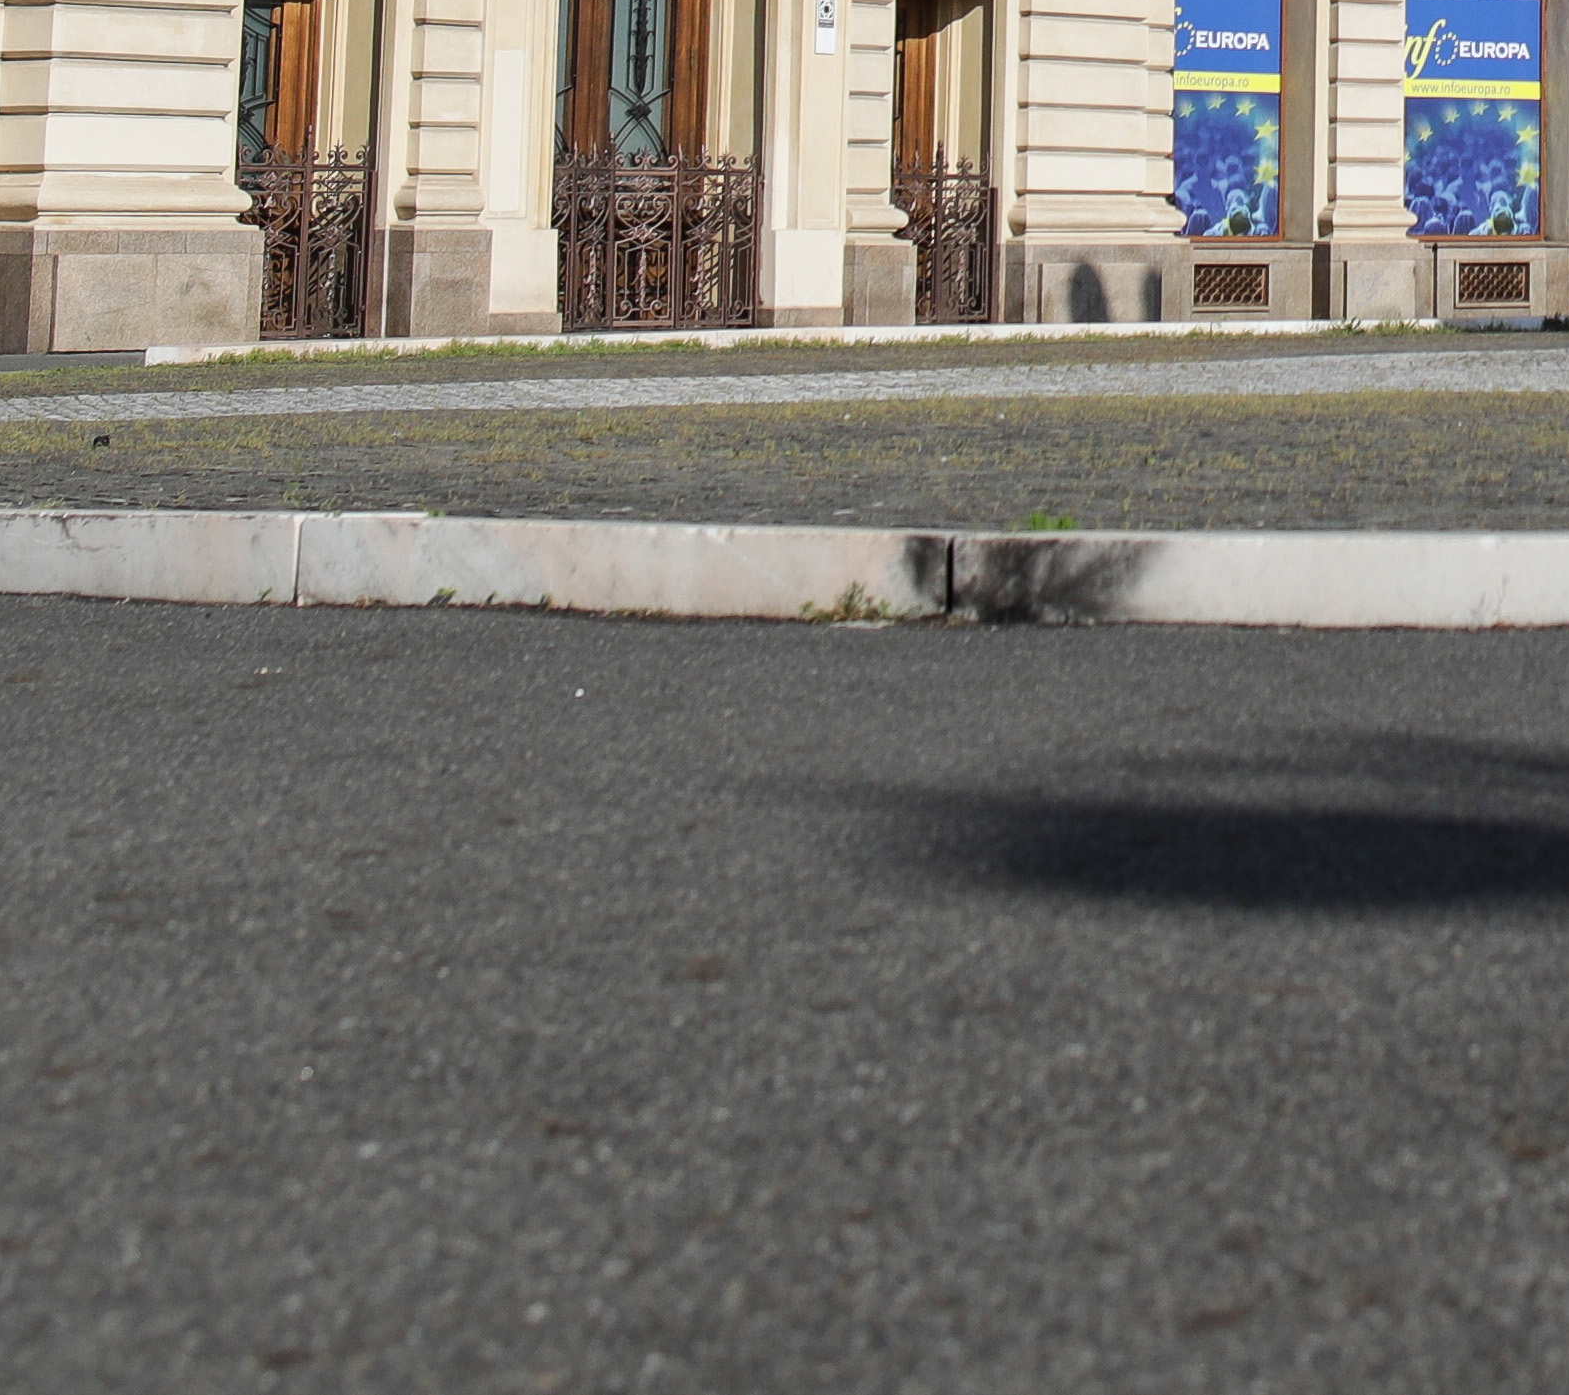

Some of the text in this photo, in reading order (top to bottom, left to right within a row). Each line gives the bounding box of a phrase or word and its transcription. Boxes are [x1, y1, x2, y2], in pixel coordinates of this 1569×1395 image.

[1194, 29, 1270, 51] EUROPA
[1459, 40, 1530, 60] EUROPA
[1411, 80, 1512, 98] www.infoeuropa.ro
